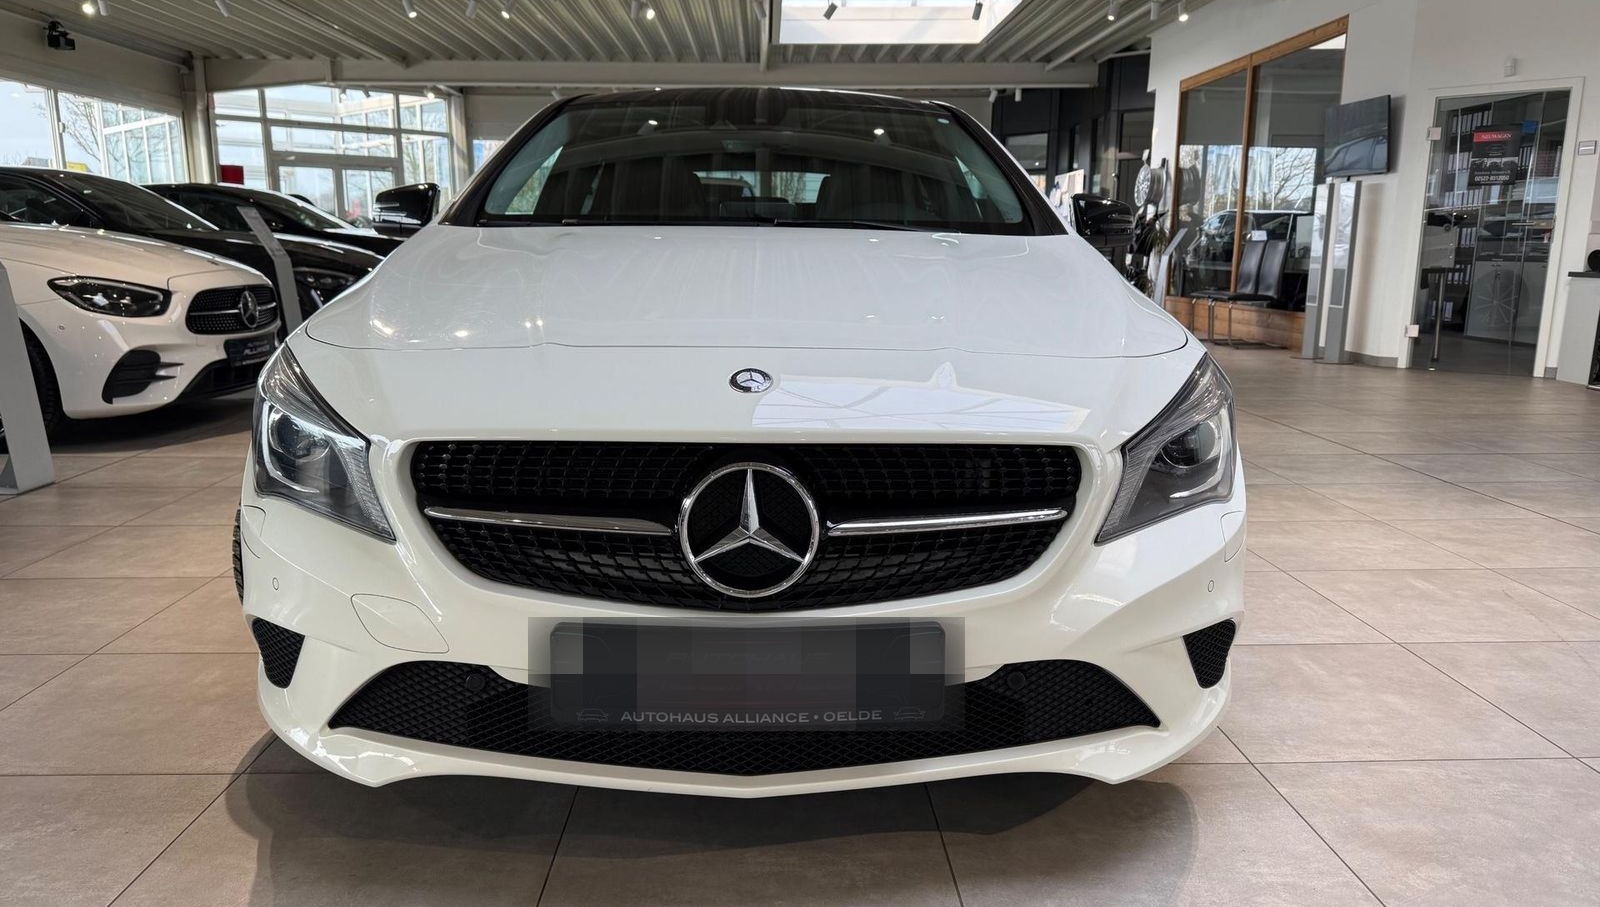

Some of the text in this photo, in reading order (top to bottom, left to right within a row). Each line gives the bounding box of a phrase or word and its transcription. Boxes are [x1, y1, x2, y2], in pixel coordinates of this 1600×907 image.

[621, 711, 719, 724] AUTOHAUS
[722, 712, 810, 724] ALLIANCE
[823, 710, 883, 722] OELDE
